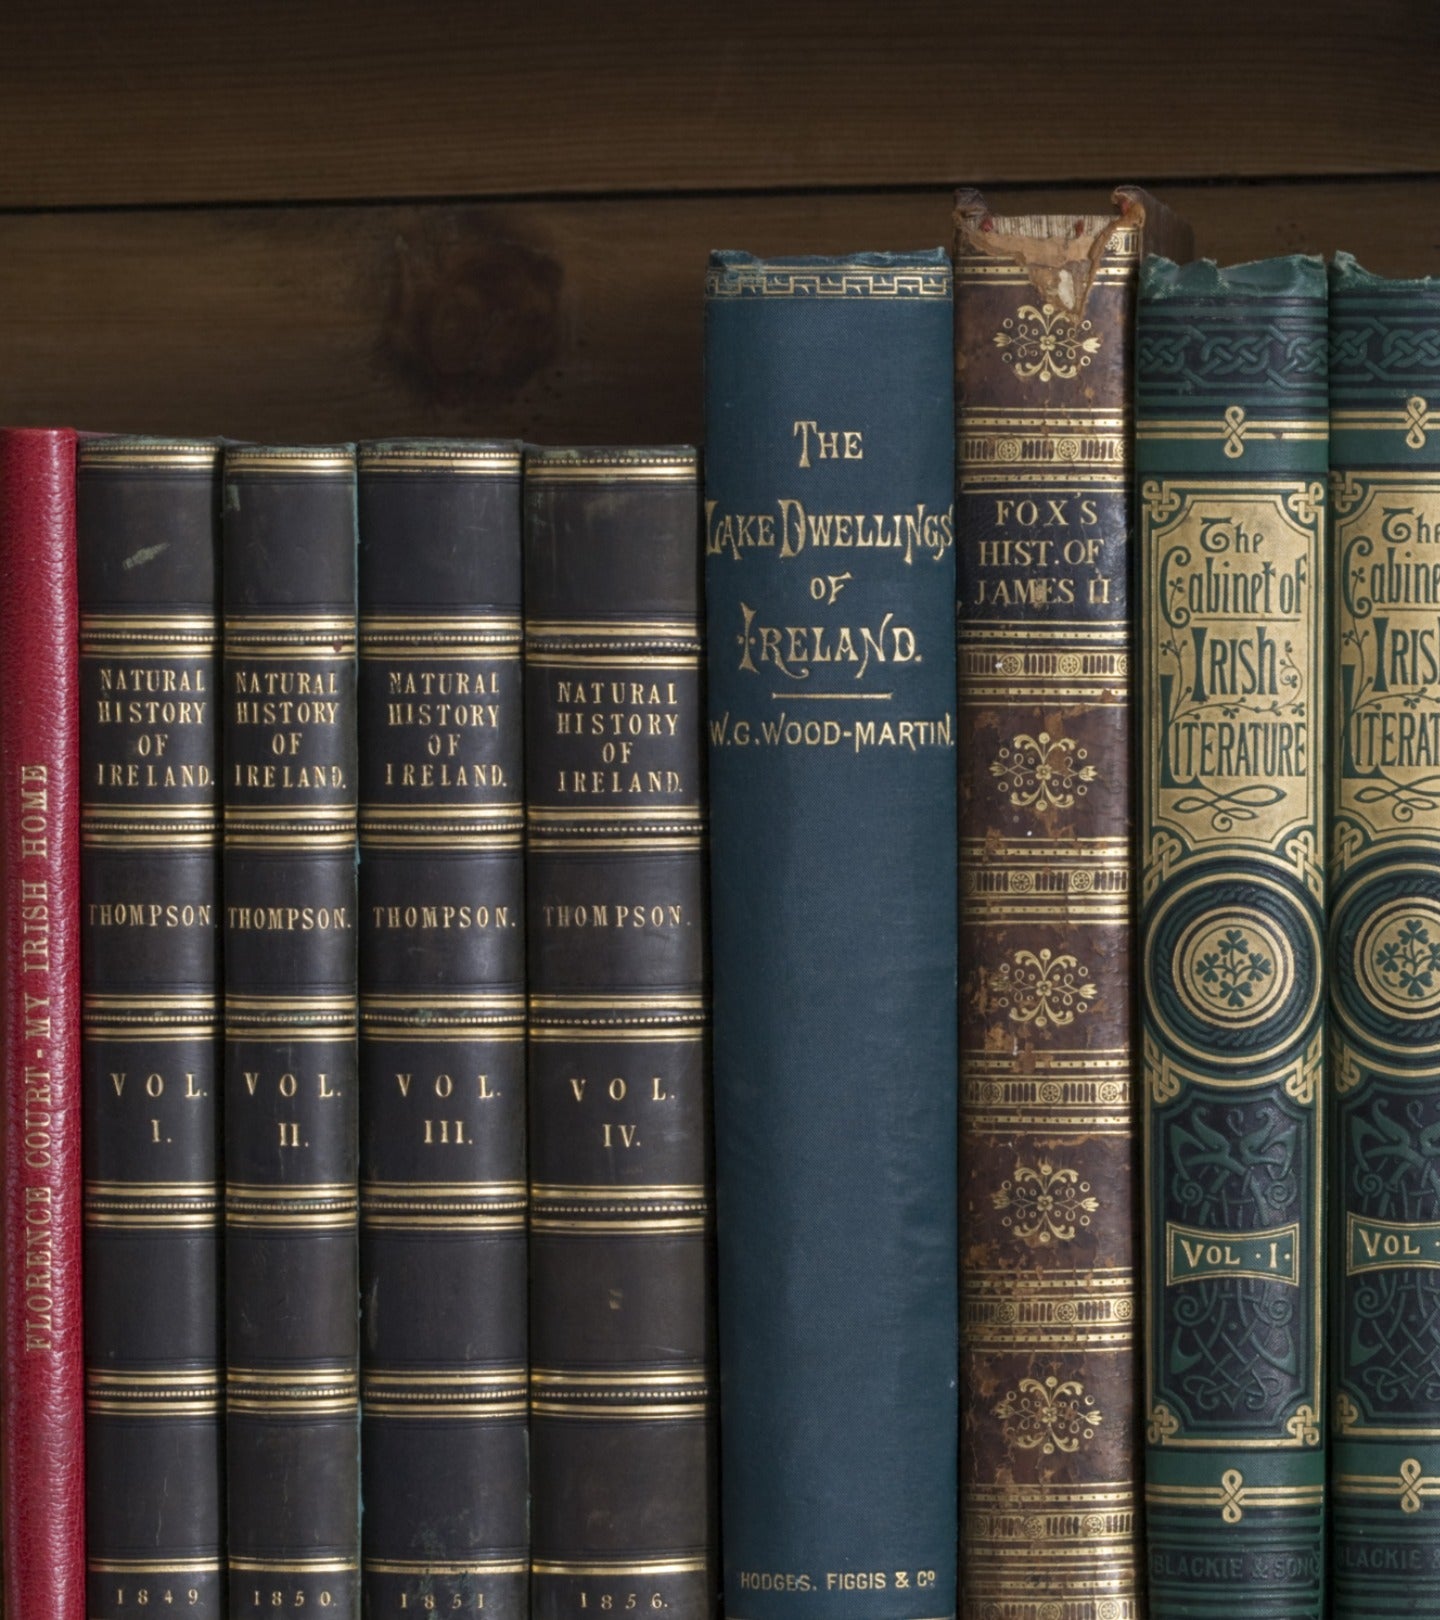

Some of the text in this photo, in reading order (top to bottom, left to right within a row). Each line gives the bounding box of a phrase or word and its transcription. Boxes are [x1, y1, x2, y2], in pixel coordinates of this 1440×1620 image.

[794, 421, 863, 467] THE
[705, 499, 953, 565] LAKE DWELLINGS
[1201, 517, 1263, 553] The
[810, 572, 853, 605] OF
[974, 577, 1074, 606] JAMES
[1160, 545, 1307, 628] Cabinet of
[100, 669, 205, 691] NATURAL
[235, 671, 338, 695] NATURAL
[389, 672, 500, 695] NATURAL
[557, 682, 678, 704] NATURAL
[98, 702, 206, 724] HISTORY
[237, 702, 339, 724] HISTORY
[388, 704, 500, 727] HISTORY
[556, 713, 679, 735] HISTORY
[138, 734, 168, 756] OF
[272, 732, 302, 755] OF
[428, 734, 461, 756] OF
[602, 742, 633, 764] OF
[97, 763, 215, 786] IRELAND.
[234, 764, 346, 789] IRELAND.
[385, 764, 507, 787] IRELAND.
[557, 771, 683, 793] IRELAND.
[21, 765, 48, 858] HOME
[22, 880, 50, 972] IRISH
[228, 907, 351, 930] THOMPSON.
[373, 906, 516, 928] THOMPSON.
[25, 992, 50, 1039] MY
[110, 1072, 208, 1097] VOL.
[243, 1073, 341, 1098] VOL.
[396, 1073, 501, 1098] VOL.
[570, 1077, 674, 1101] VOL.
[25, 1066, 51, 1168] COURT
[151, 1119, 171, 1143] I.
[278, 1123, 309, 1147] II.
[423, 1120, 473, 1145] III.
[603, 1123, 641, 1148] IV.
[26, 1187, 52, 1351] FLORENCE
[1154, 1555, 1243, 1579] BLACKIE
[826, 1572, 886, 1590] FIGGIS
[895, 1571, 909, 1588] &
